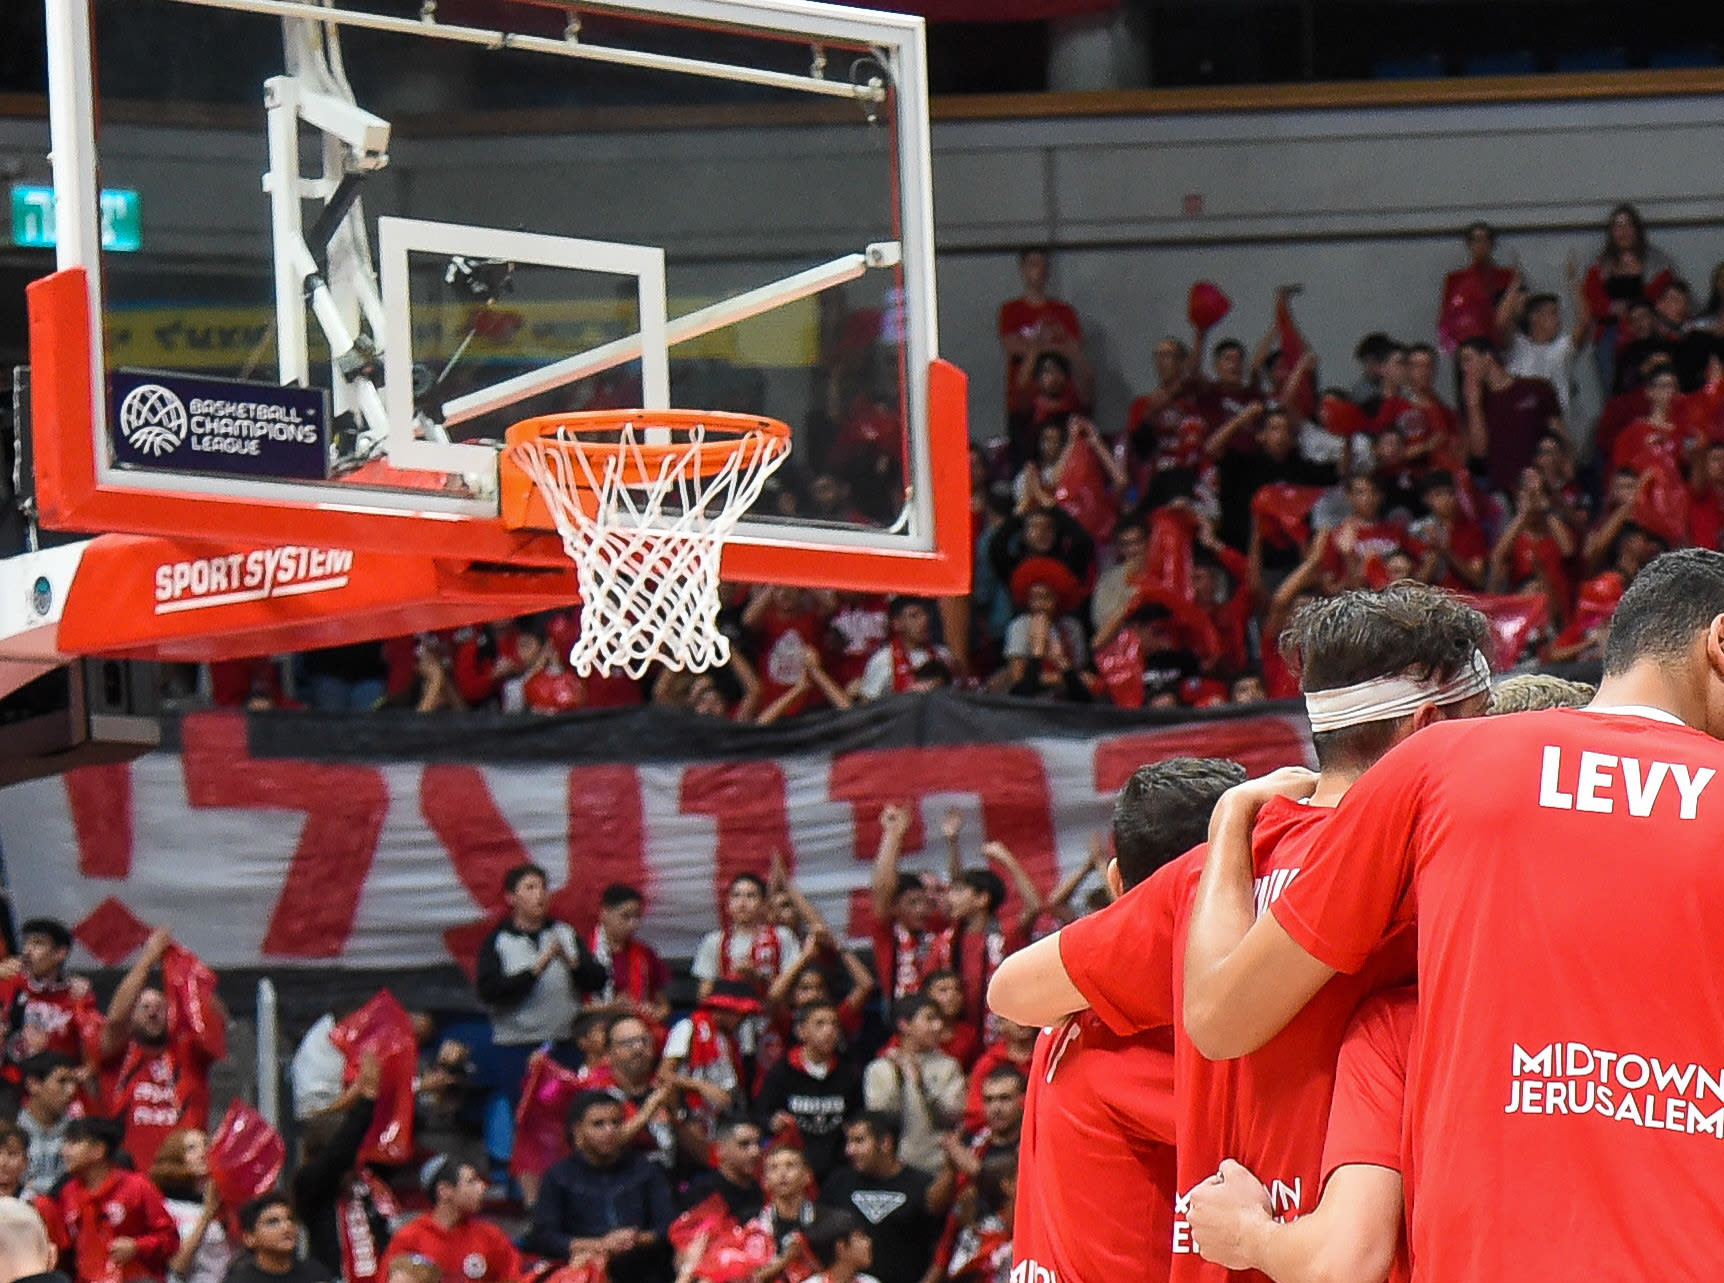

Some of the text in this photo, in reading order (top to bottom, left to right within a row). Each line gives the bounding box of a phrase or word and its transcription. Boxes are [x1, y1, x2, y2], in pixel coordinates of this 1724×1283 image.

[189, 397, 303, 423] BASKETBALL
[190, 415, 318, 444] CHAMPIONS
[191, 435, 262, 456] LEAGUE
[1539, 745, 1717, 820] LEVY
